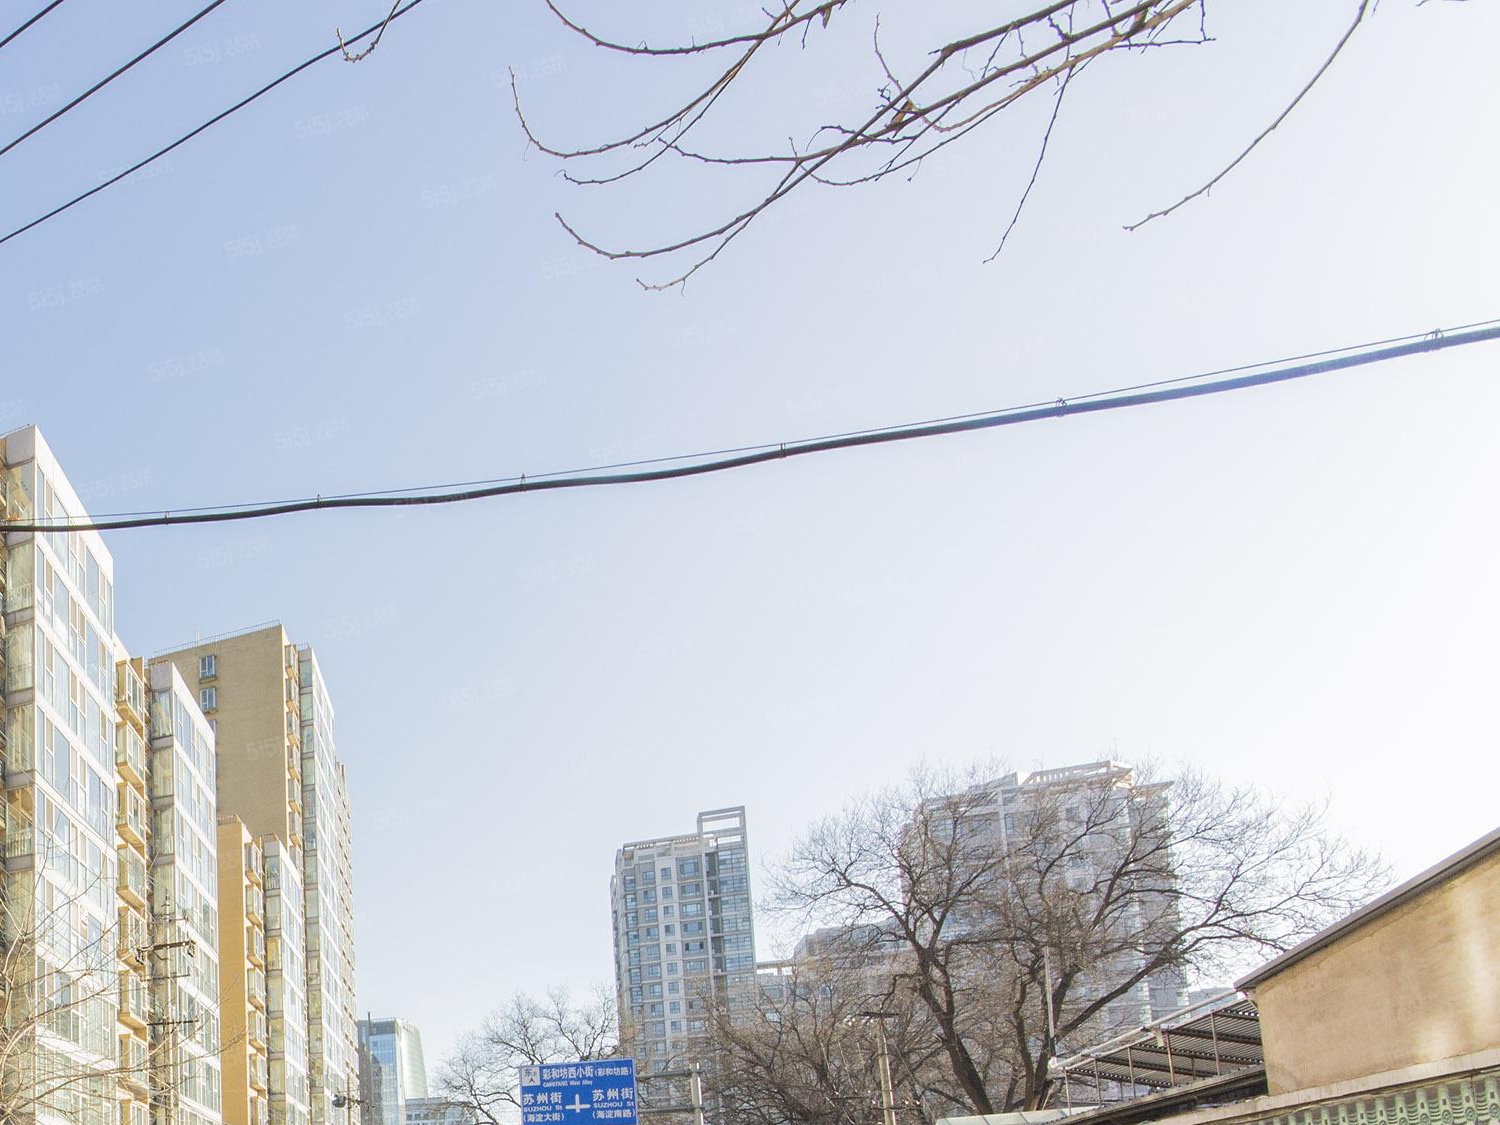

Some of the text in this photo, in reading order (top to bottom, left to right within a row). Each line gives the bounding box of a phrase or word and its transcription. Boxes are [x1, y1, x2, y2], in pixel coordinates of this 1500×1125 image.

[523, 1092, 562, 1105] 苏州街
[592, 1087, 633, 1101] 苏州街
